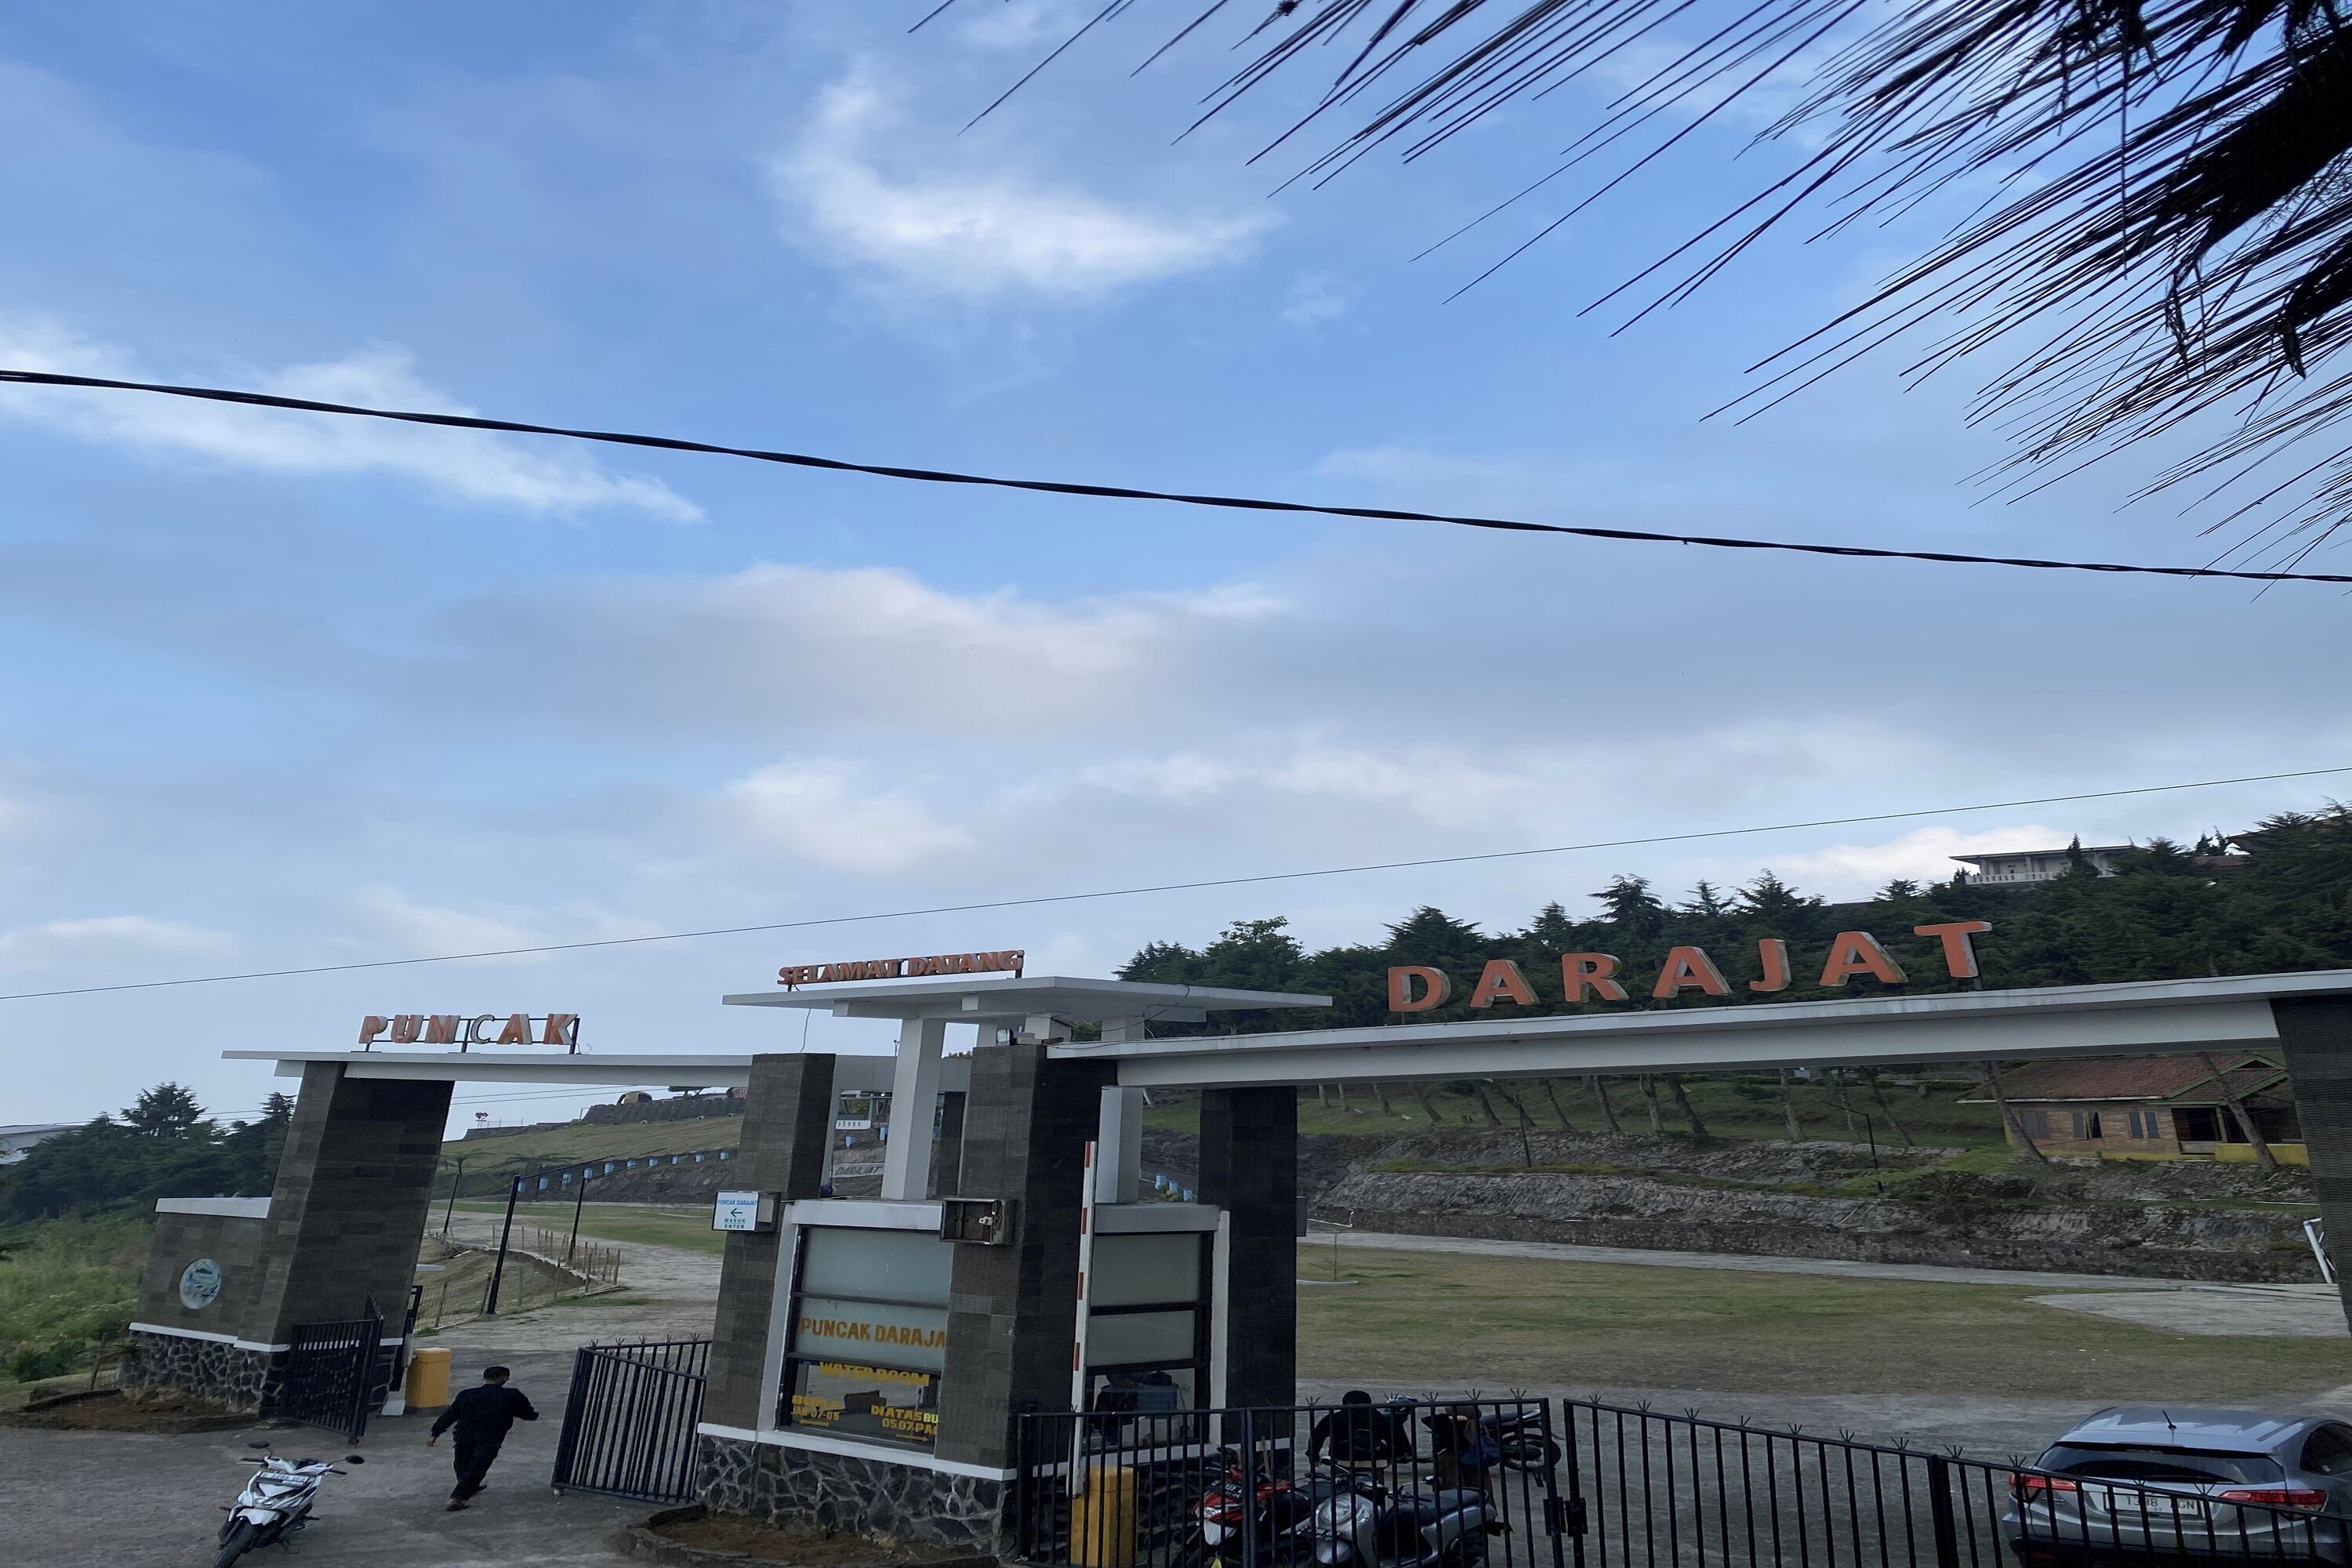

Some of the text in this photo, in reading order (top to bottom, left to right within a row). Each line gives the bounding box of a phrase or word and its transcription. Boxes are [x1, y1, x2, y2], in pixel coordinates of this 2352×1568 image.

[777, 950, 1024, 985] SELAMAT DATANG
[1388, 920, 1993, 1012] DARAJAT
[358, 1013, 579, 1045] PUNCAK
[799, 1317, 870, 1341] PUNCAK
